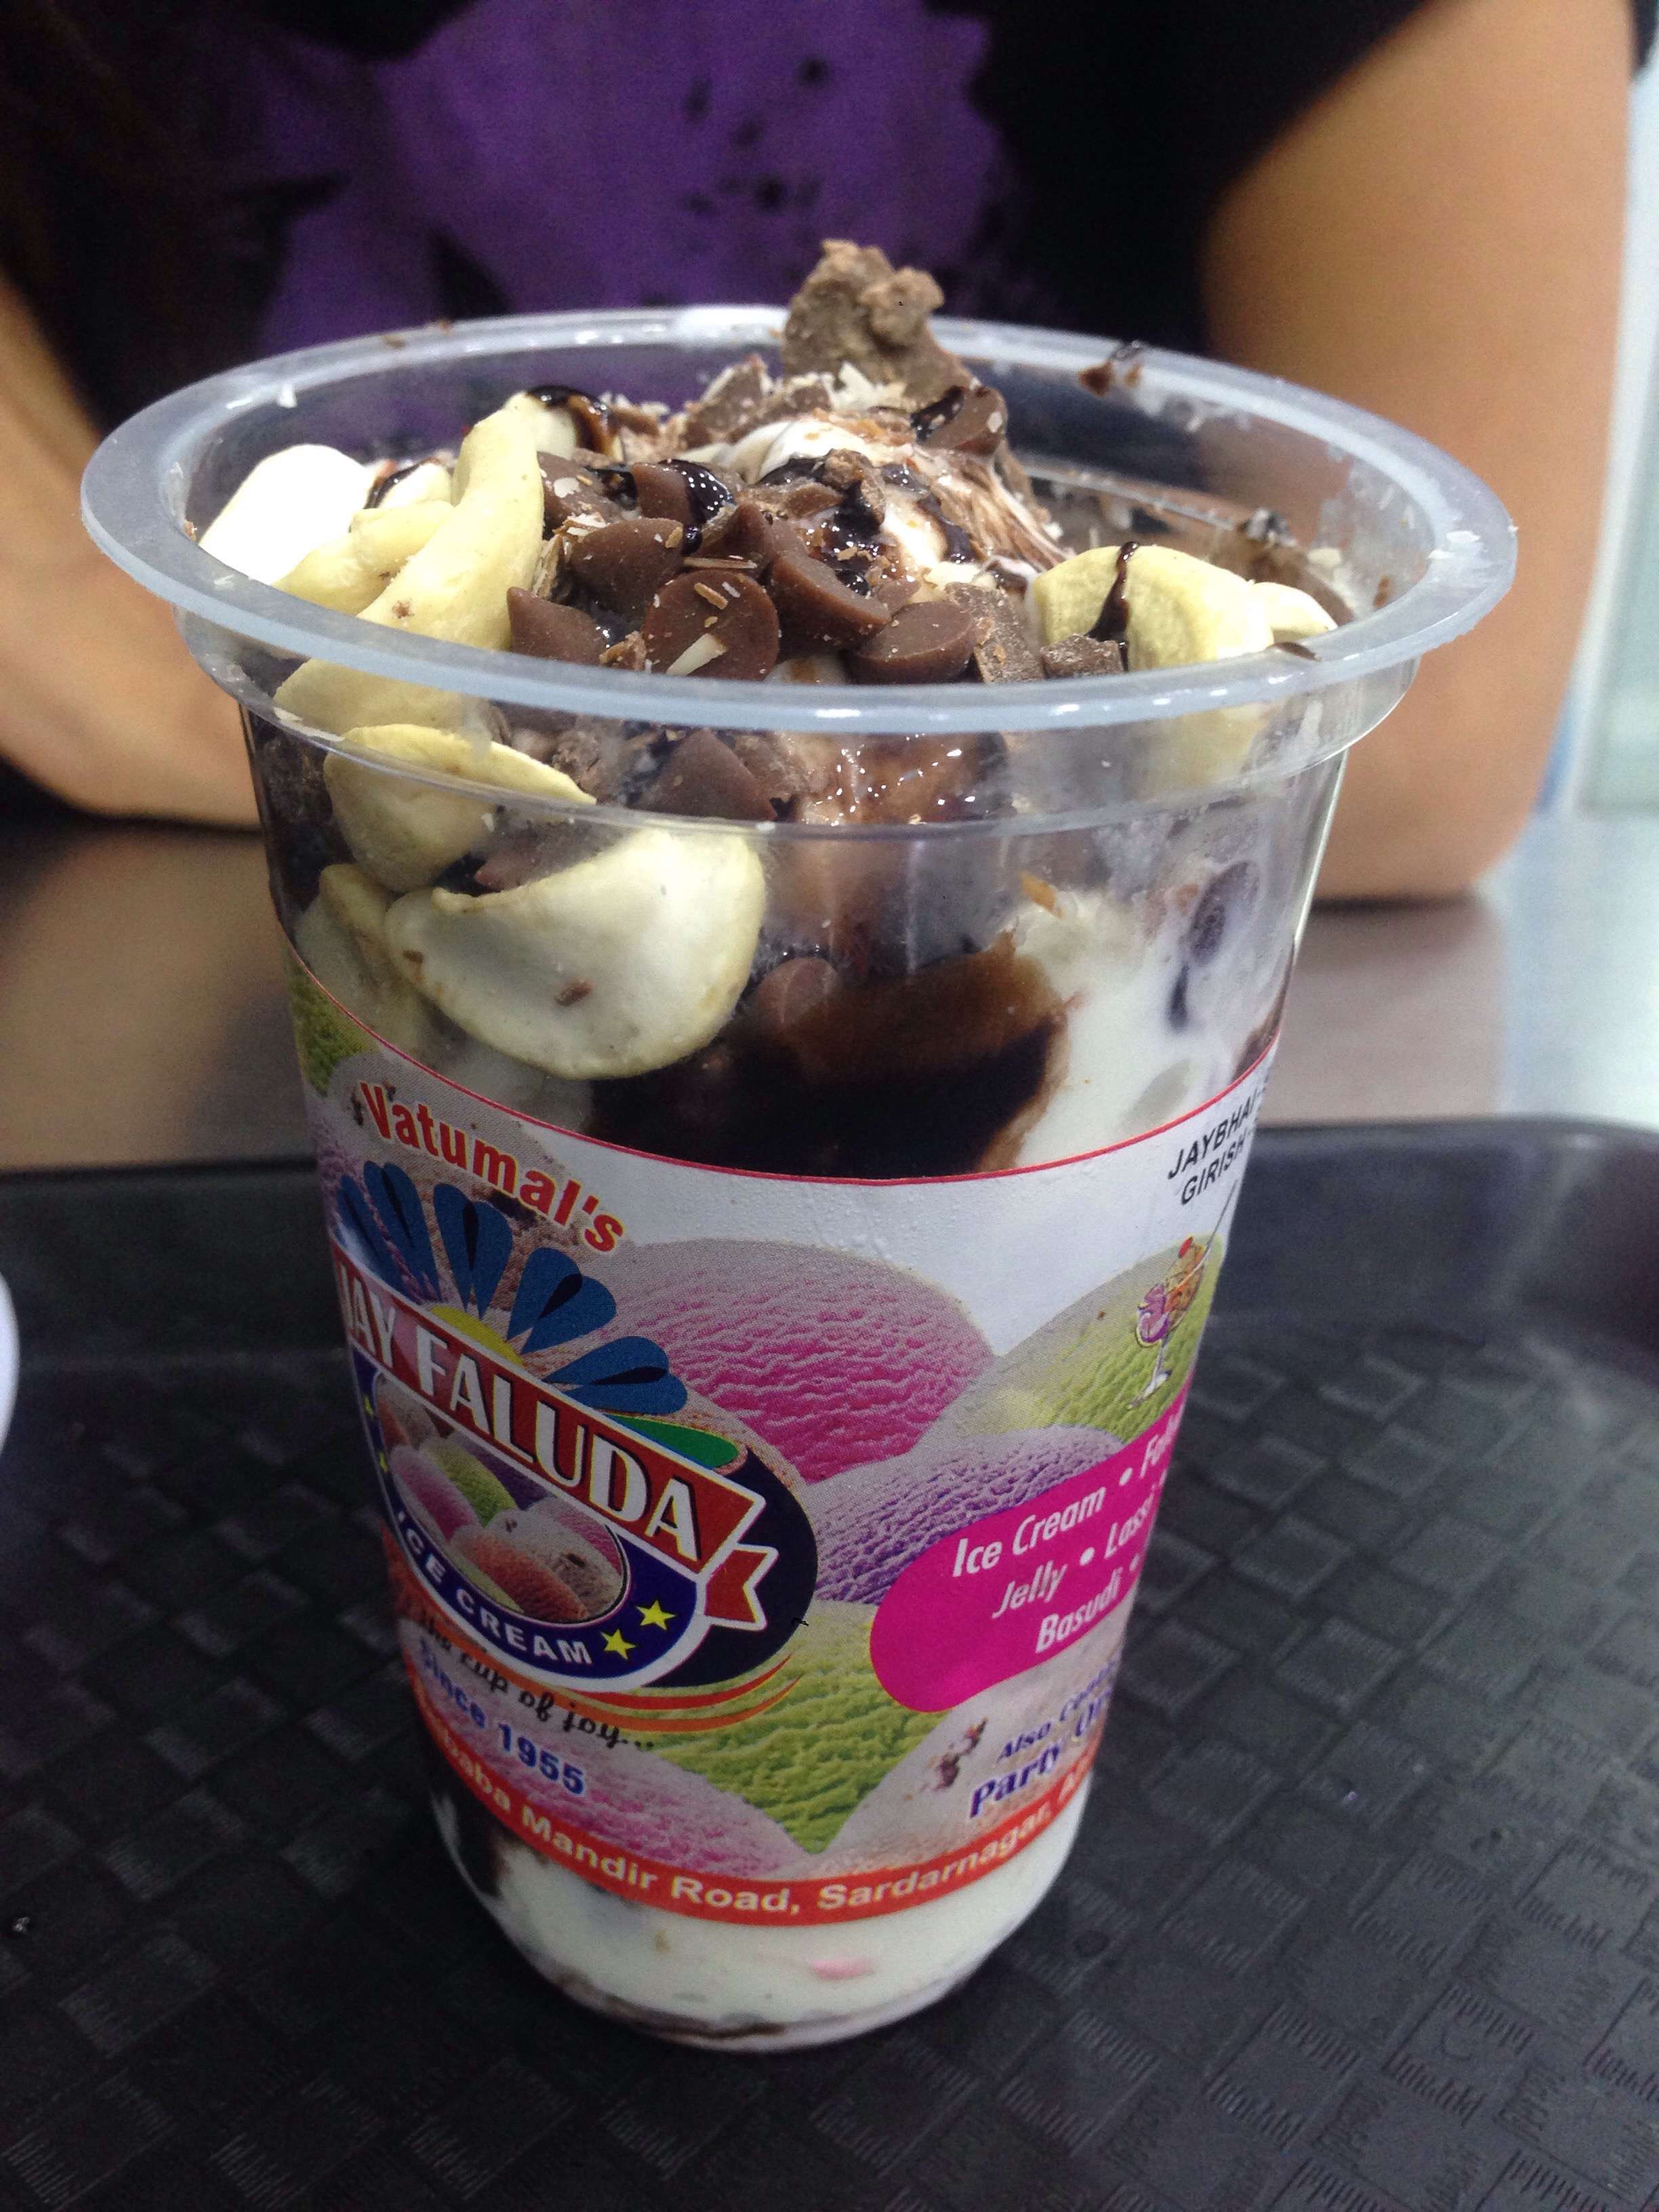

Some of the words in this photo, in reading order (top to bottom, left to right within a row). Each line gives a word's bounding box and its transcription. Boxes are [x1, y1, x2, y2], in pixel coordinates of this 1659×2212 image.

[360, 1082, 624, 1253] Vatumal's
[415, 1324, 702, 1561] FALUDA
[953, 1538, 1002, 1578] Ice
[1012, 1486, 1107, 1555] Cream
[398, 1510, 446, 1583] ICE
[455, 1589, 593, 1666] CREAM
[991, 1560, 1067, 1619] Jelly
[1035, 1566, 1124, 1654] Basudi
[459, 1652, 510, 1693] cup
[516, 1690, 555, 1723] of
[497, 1722, 586, 1796] 1955
[522, 1805, 659, 1889] Mandir
[670, 1874, 801, 1916] Road,
